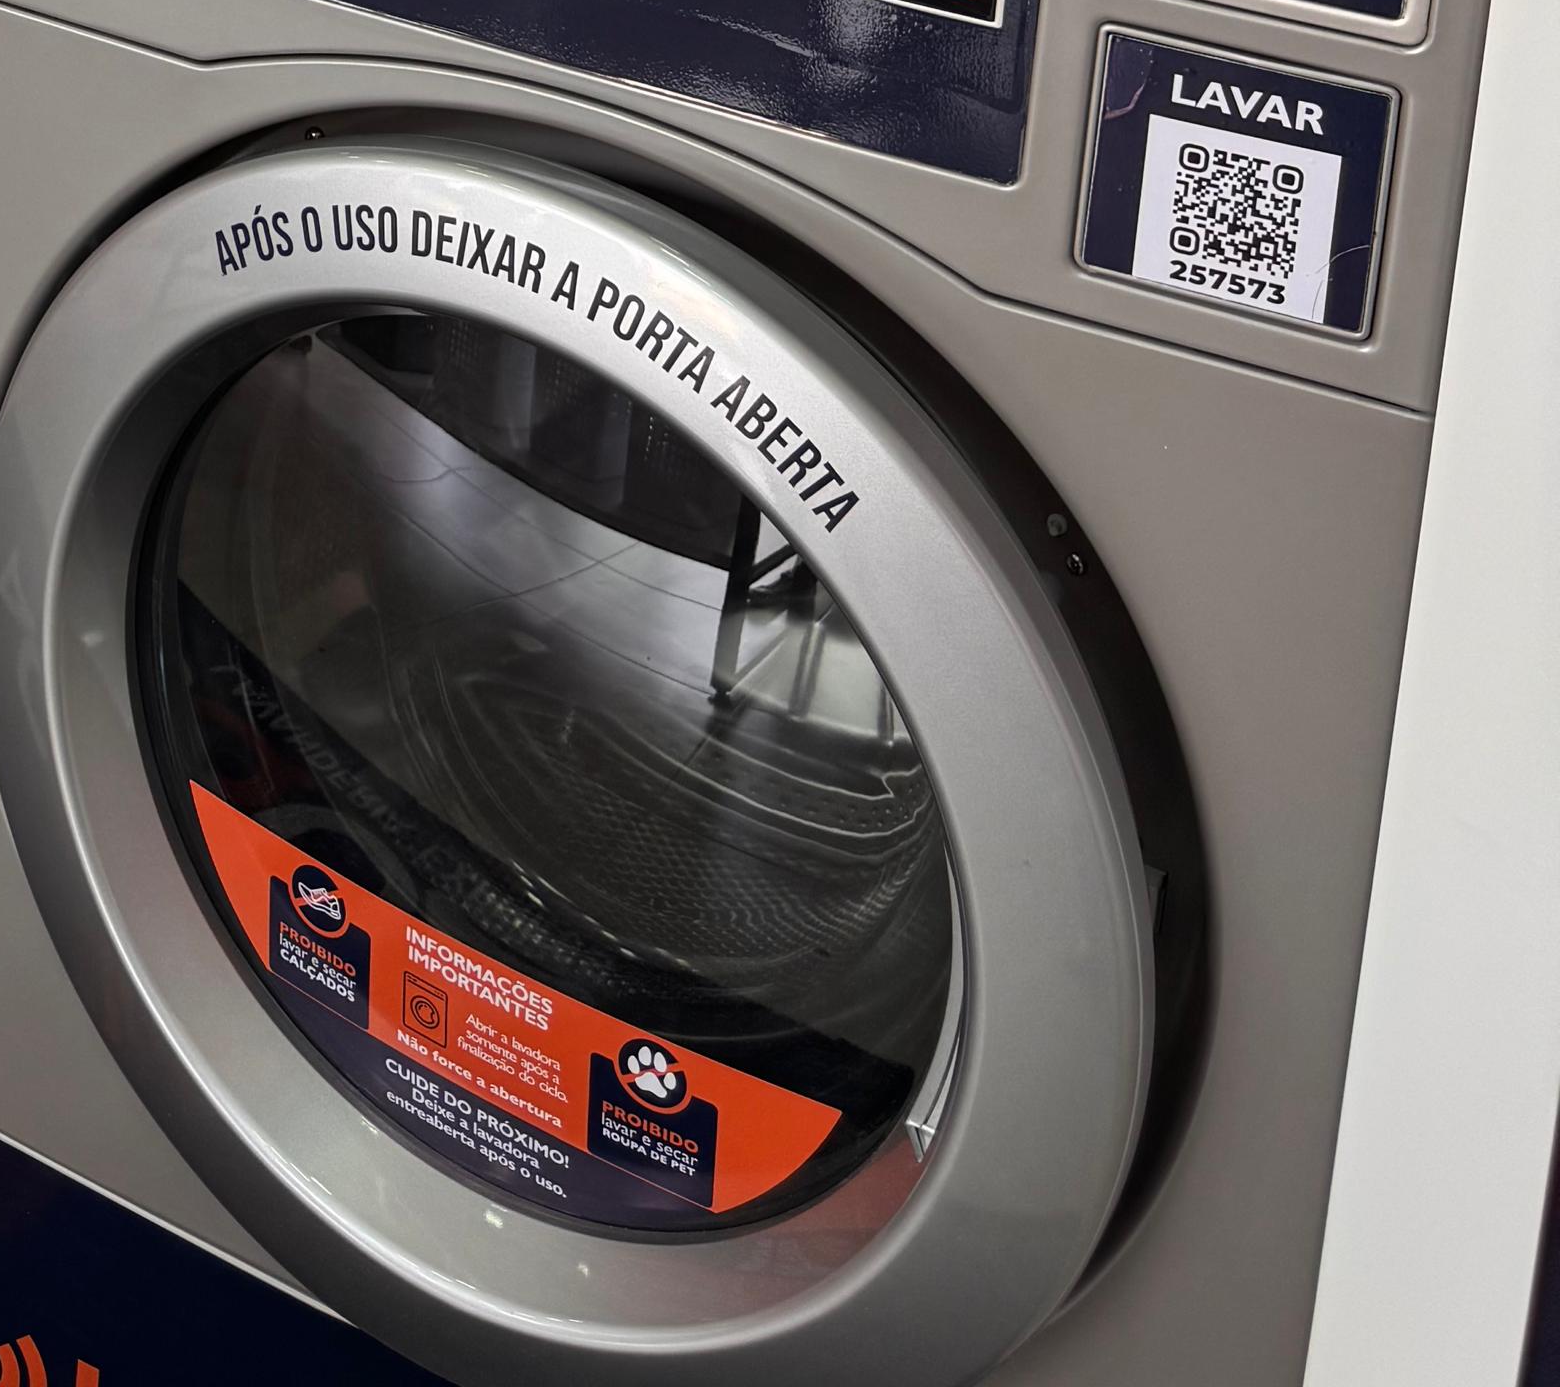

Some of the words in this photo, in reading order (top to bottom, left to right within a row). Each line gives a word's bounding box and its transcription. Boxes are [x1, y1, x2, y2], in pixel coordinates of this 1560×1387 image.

[1171, 74, 1324, 136] LAVAR
[1170, 260, 1285, 305] 257573
[214, 204, 294, 276] APÓS
[304, 206, 323, 253] O
[332, 204, 398, 253] USO
[410, 209, 545, 294] DEIXAR
[550, 260, 580, 312] A
[587, 276, 716, 394] PORTA
[710, 373, 861, 534] ABERTA
[280, 921, 356, 977] PROIBIDO
[280, 932, 308, 959] lavar
[311, 956, 319, 967] e
[322, 963, 356, 989] secar
[280, 948, 355, 1003] CALÇADOS
[406, 926, 553, 1015] INFORMAÇÕES
[408, 945, 549, 1031] IMPORTANTES
[457, 1035, 515, 1076] finalização
[518, 1068, 536, 1086] do
[539, 1080, 569, 1104] ciclo.
[466, 1014, 498, 1037] Abrir
[500, 1032, 508, 1044] a
[511, 1035, 561, 1071] lavadora
[466, 1030, 517, 1063] somente
[520, 1055, 550, 1079] após
[552, 1073, 560, 1085] a
[397, 1029, 428, 1056] Não
[432, 1050, 472, 1081] force
[476, 1076, 487, 1089] a
[490, 1079, 563, 1128] abertura
[385, 1058, 440, 1097] CUIDE
[443, 1090, 472, 1115] DO
[477, 1109, 570, 1169] PRÓXIMO!
[412, 1087, 455, 1122] Deixe
[459, 1117, 469, 1130] a
[473, 1119, 540, 1169] lavadora
[602, 1100, 699, 1154] PROIBIDO
[602, 1111, 637, 1138] lavar
[642, 1135, 651, 1146] e
[657, 1142, 698, 1166] secar
[386, 1090, 476, 1150] entreaberta
[479, 1144, 516, 1172] após
[520, 1165, 531, 1179] o
[535, 1174, 567, 1198] uso.
[602, 1127, 647, 1156] ROUPA
[650, 1150, 667, 1165] DE
[671, 1159, 696, 1176] PET
